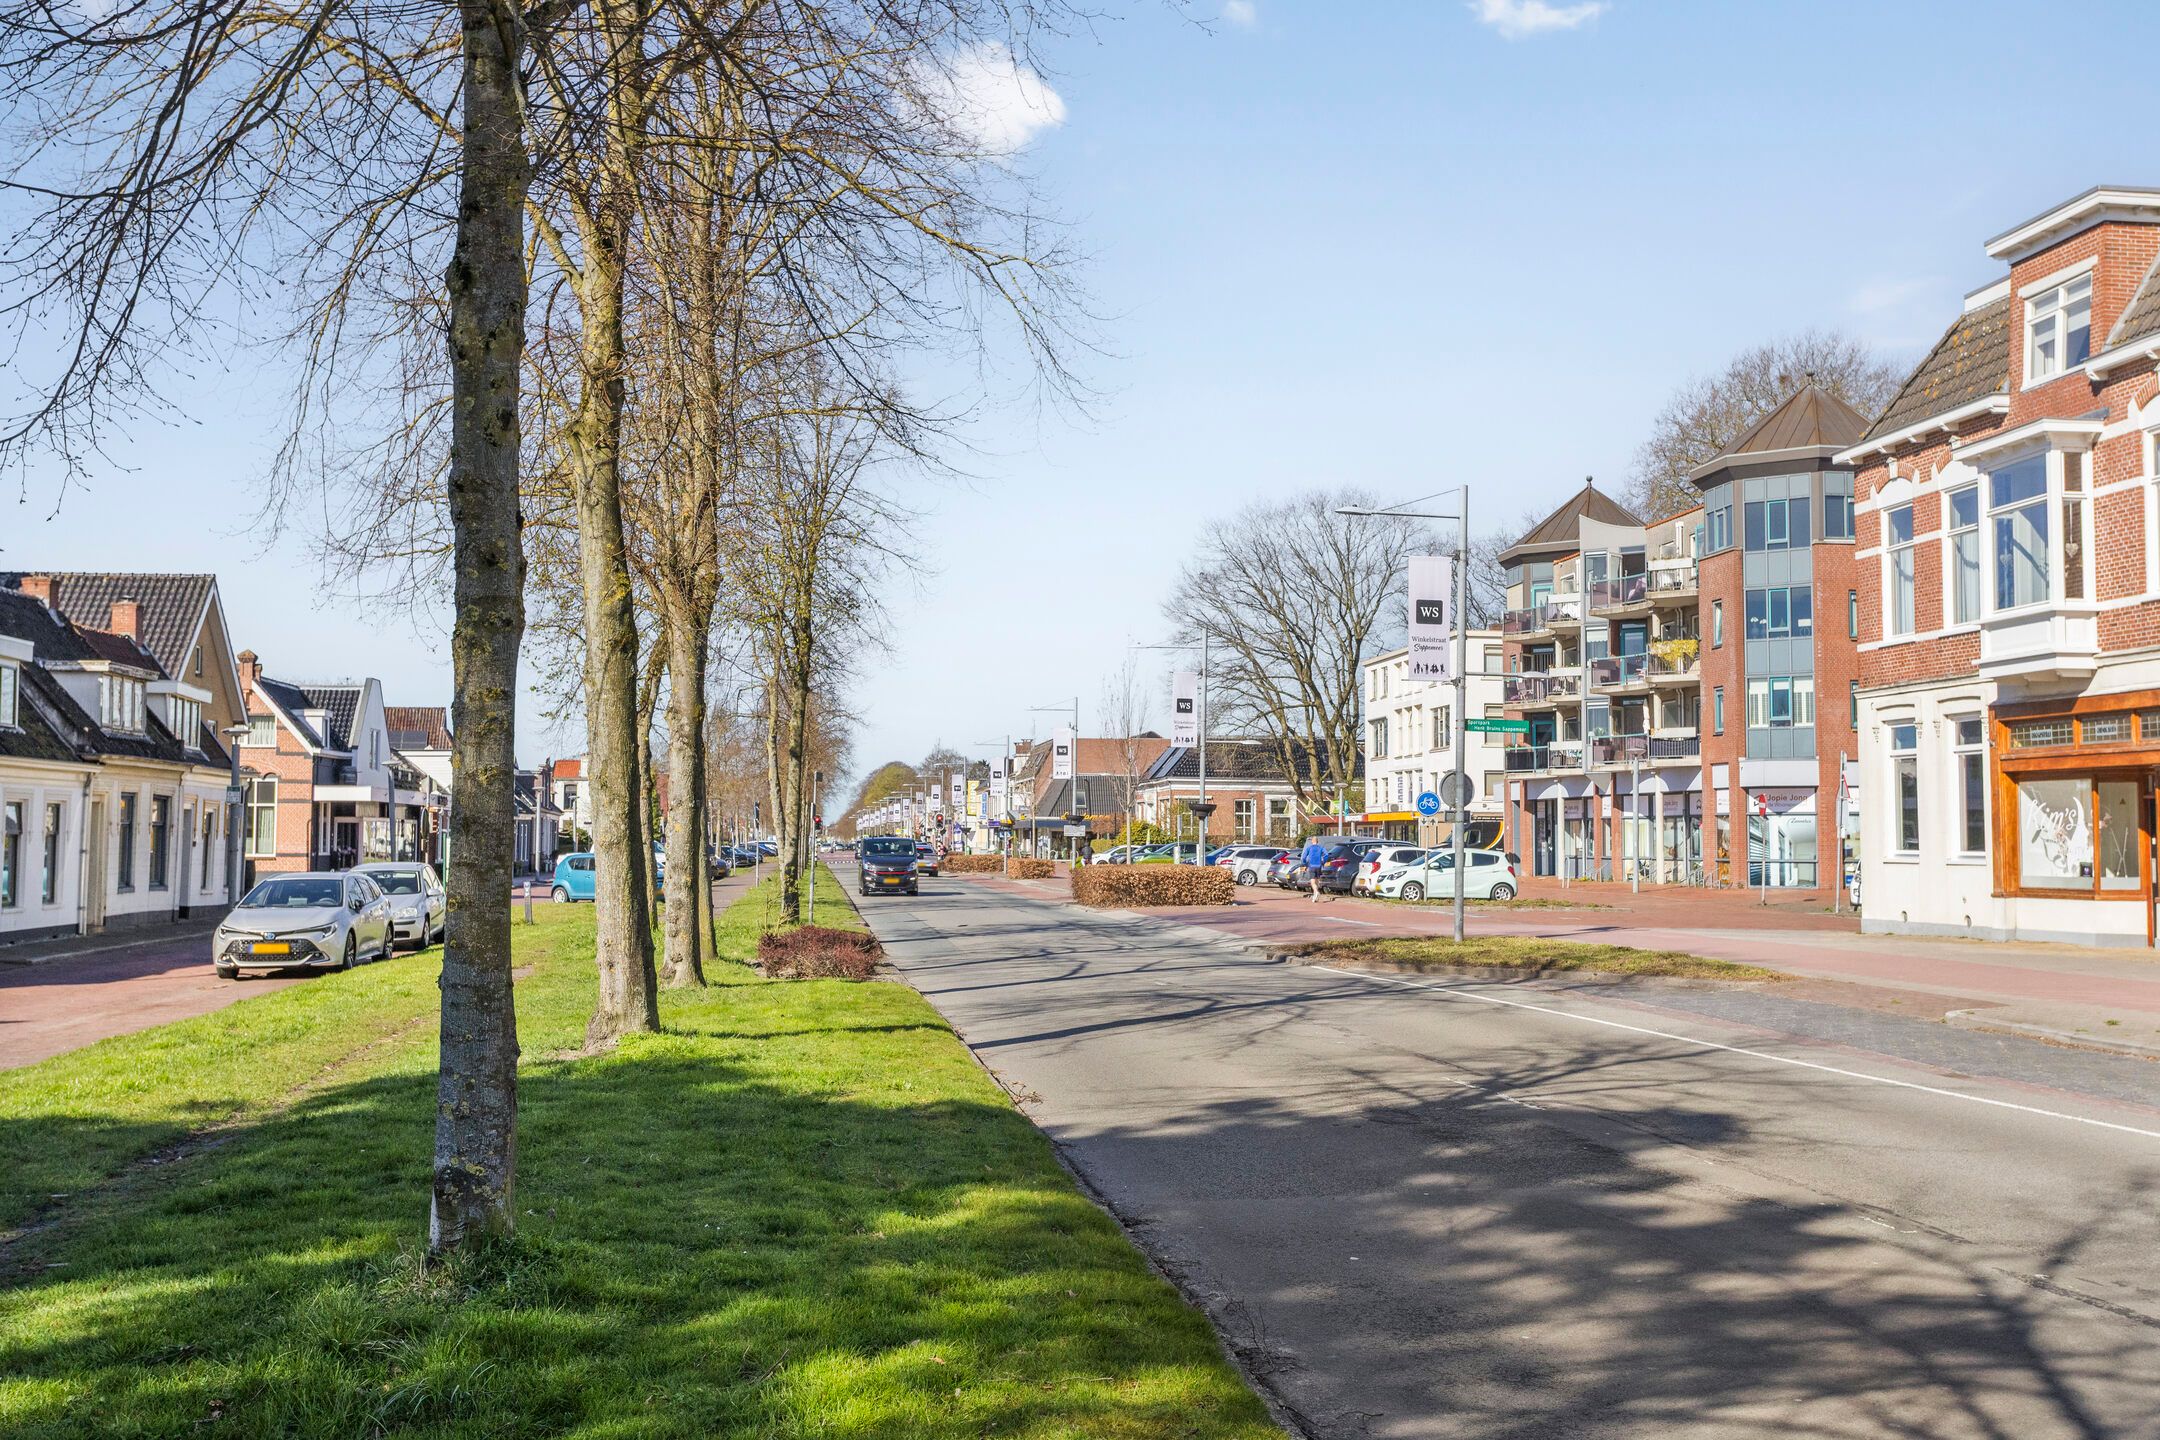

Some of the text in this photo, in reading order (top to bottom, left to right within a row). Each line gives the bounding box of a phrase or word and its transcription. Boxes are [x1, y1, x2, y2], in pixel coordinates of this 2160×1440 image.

[1420, 606, 1439, 618] WS
[1179, 702, 1191, 710] WS
[1768, 794, 1788, 802] Jopie
